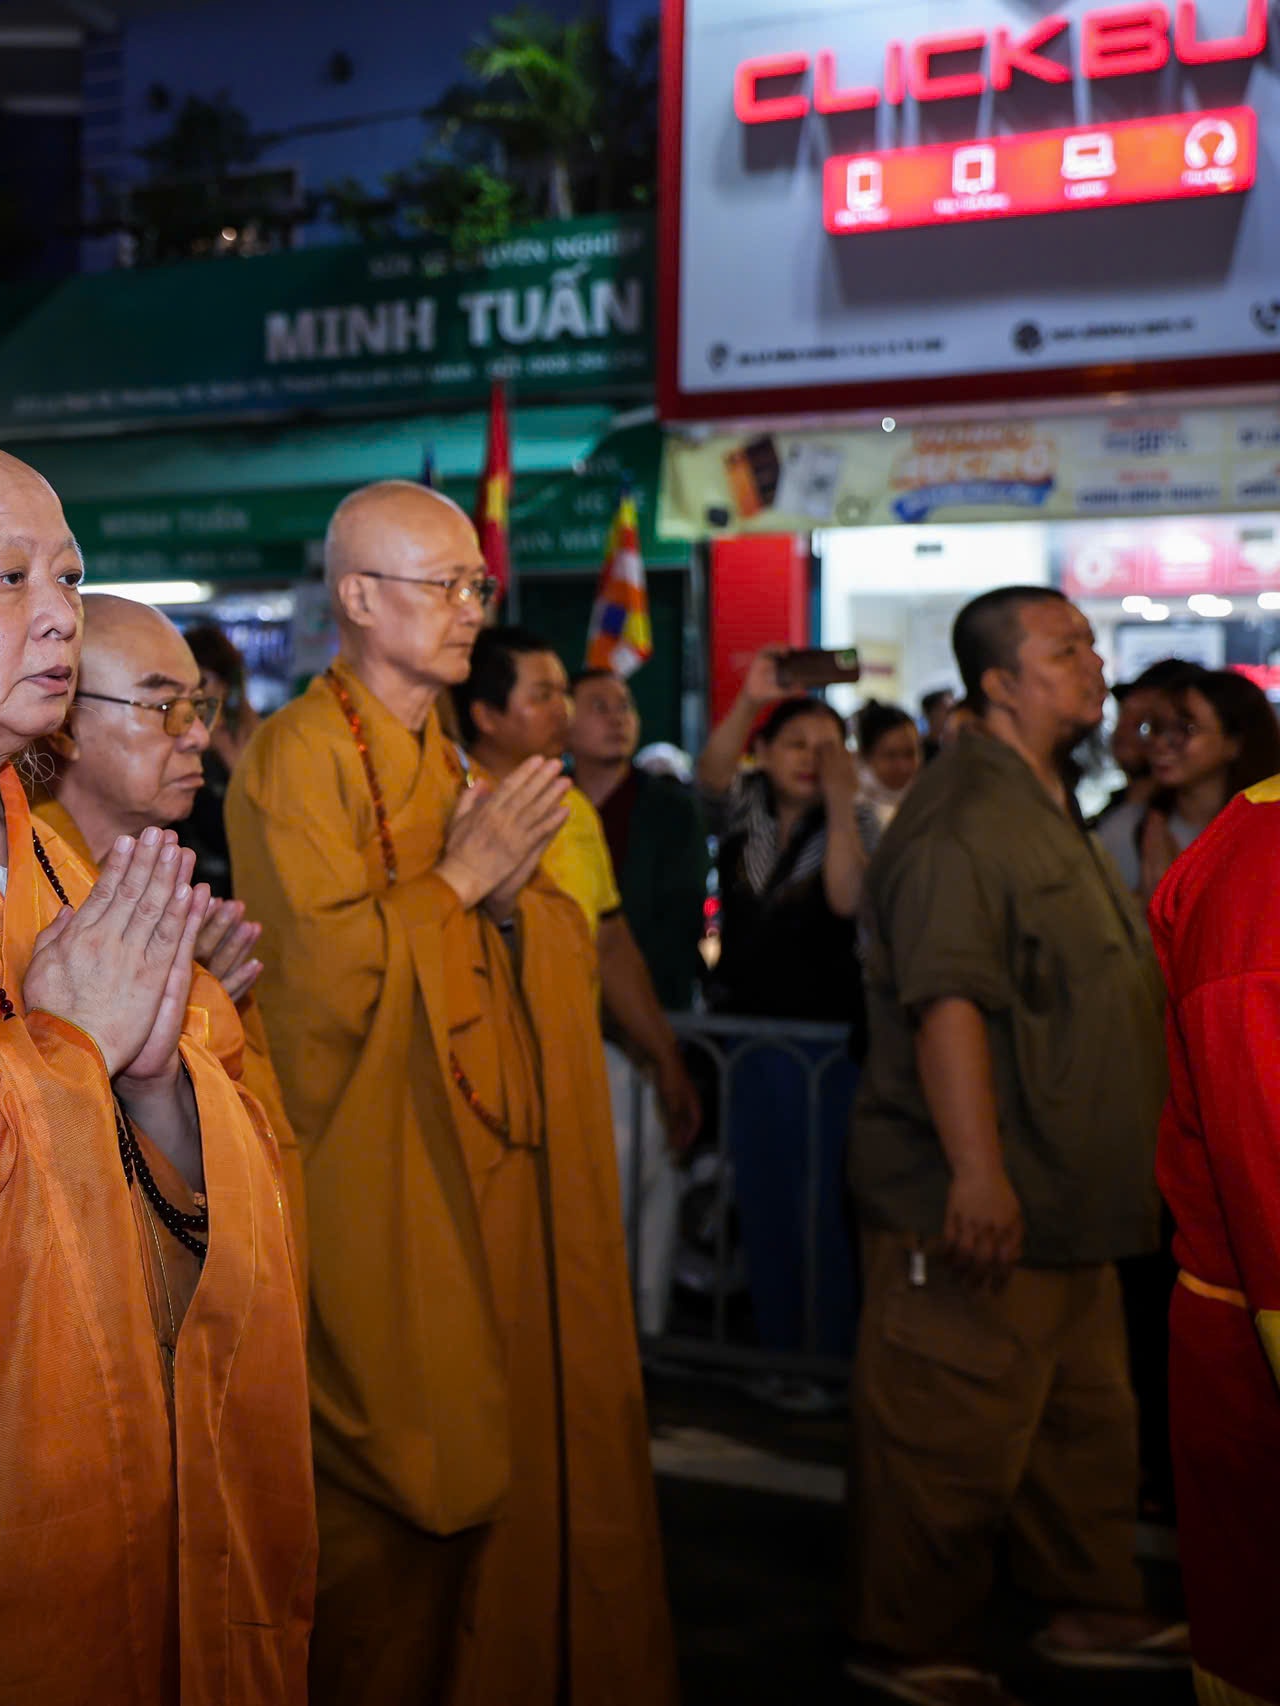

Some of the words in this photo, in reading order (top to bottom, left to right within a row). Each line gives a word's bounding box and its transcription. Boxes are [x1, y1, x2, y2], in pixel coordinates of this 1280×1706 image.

[734, 0, 1268, 124] CLICKBU
[264, 297, 437, 364] MINH
[459, 264, 640, 346] TUẤN
